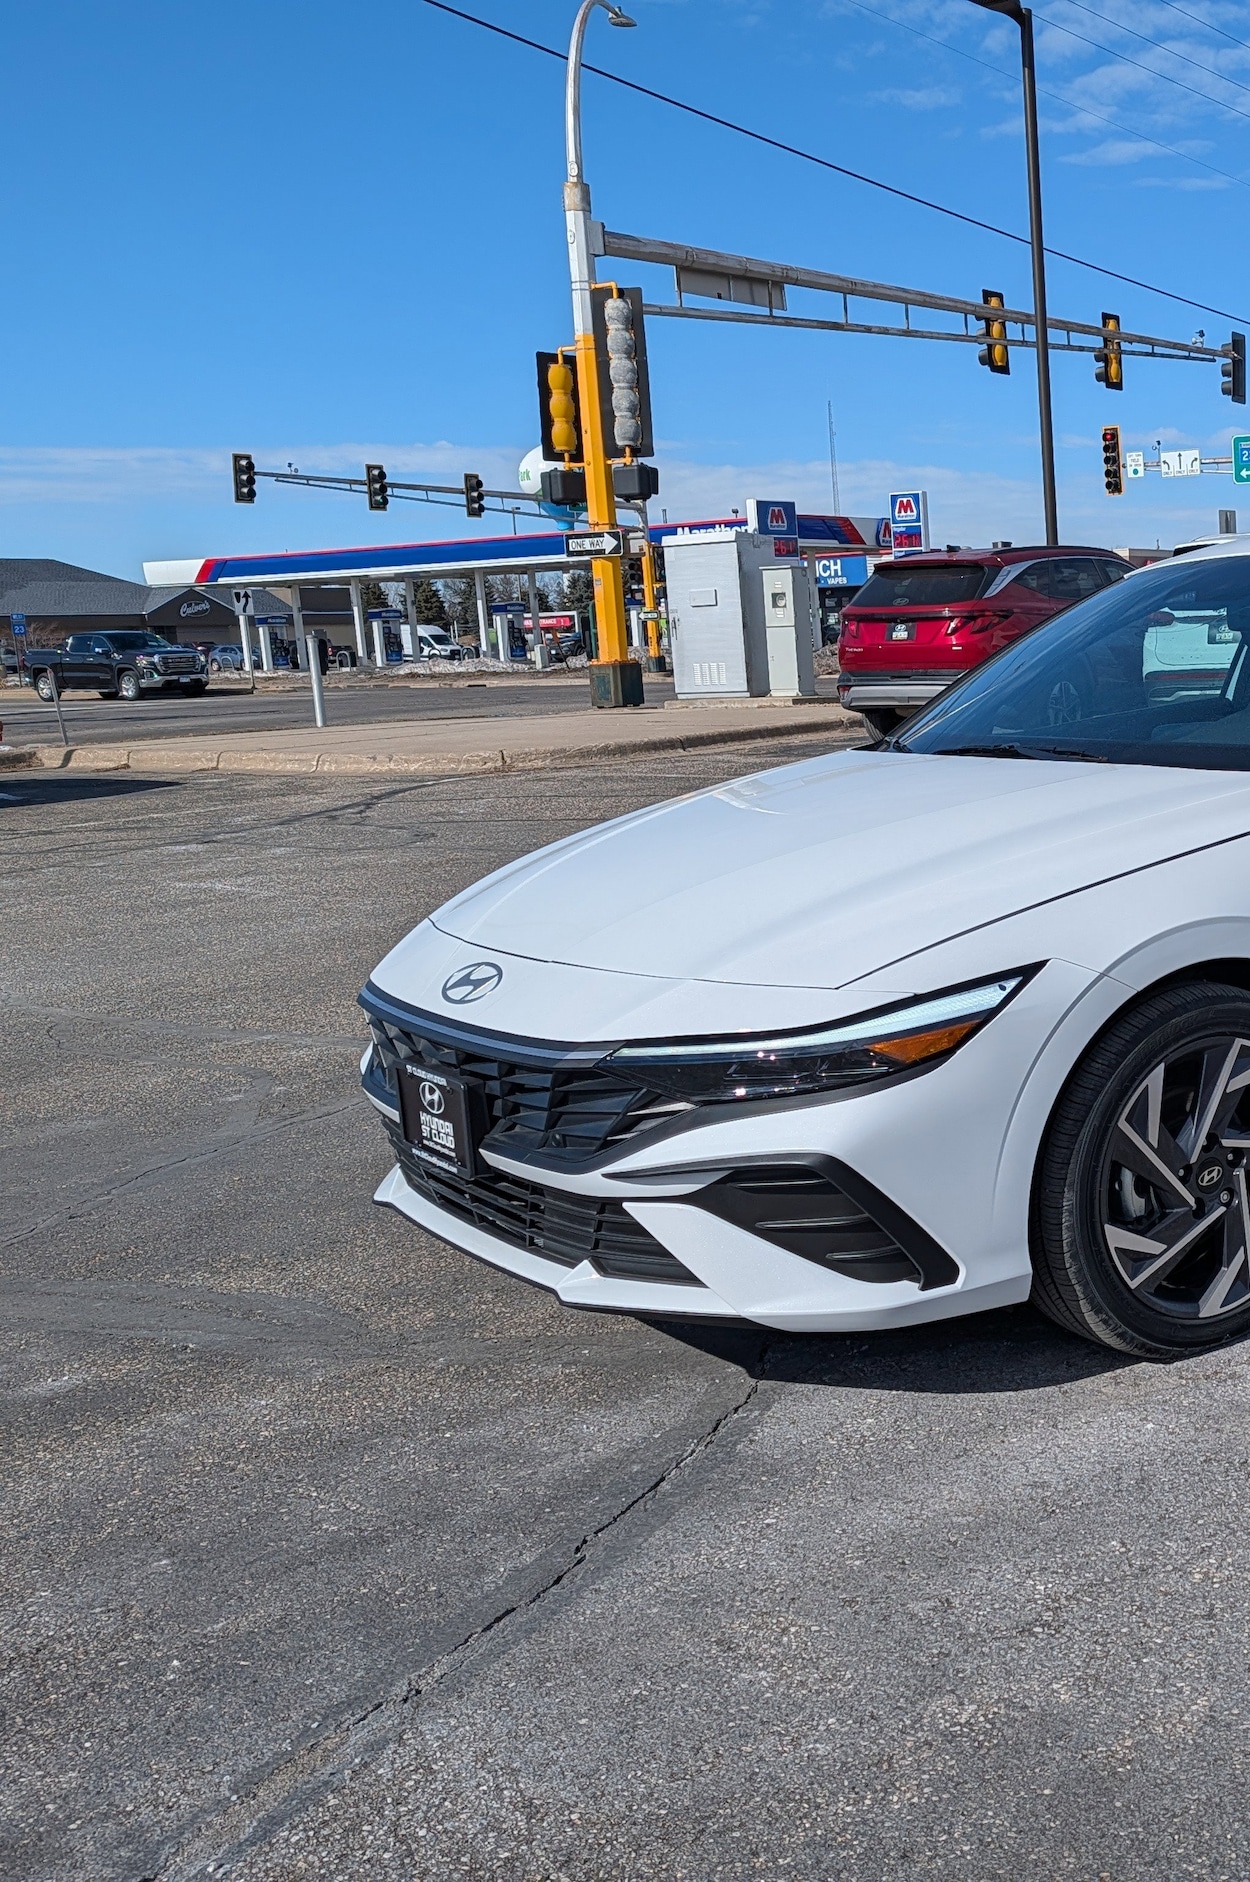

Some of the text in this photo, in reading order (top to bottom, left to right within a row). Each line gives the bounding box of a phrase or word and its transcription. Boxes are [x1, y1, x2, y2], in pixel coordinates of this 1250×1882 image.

[571, 539, 604, 550] ONE WAY
[179, 600, 211, 618] Culver's
[14, 625, 25, 633] 23
[420, 1110, 454, 1137] HYUNDAI
[421, 1124, 455, 1149] ST CLOUD
